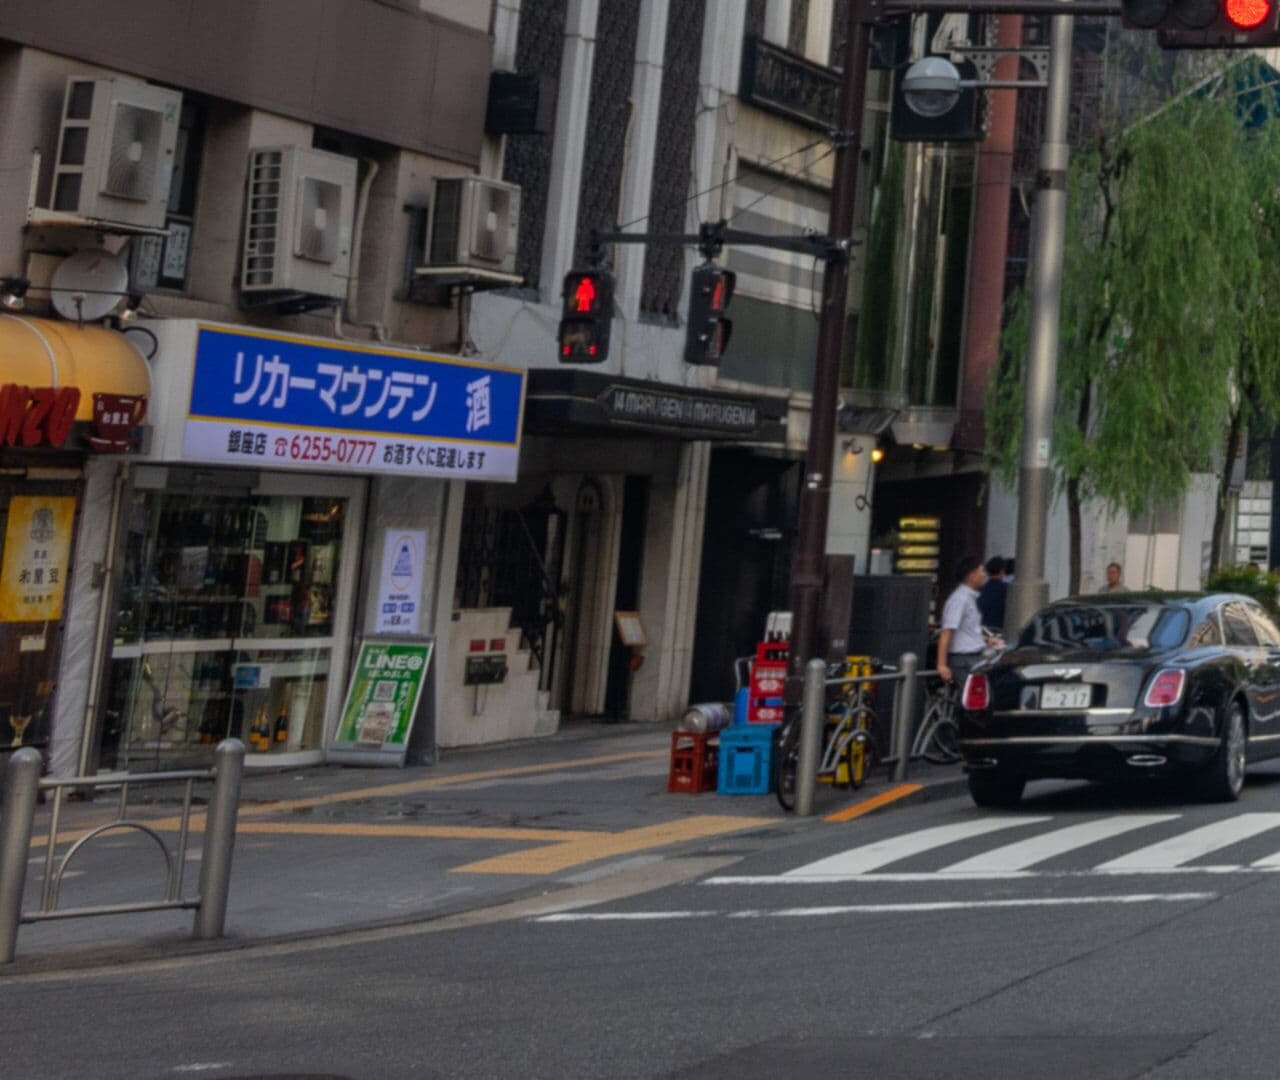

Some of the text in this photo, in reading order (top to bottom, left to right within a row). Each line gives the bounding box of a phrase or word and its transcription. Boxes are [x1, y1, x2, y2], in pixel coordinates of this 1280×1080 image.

[233, 351, 492, 433] リカーマウンテン 酒
[227, 429, 268, 455] 銀座店
[290, 434, 377, 465] 6255-0777
[364, 654, 423, 670] LINE@
